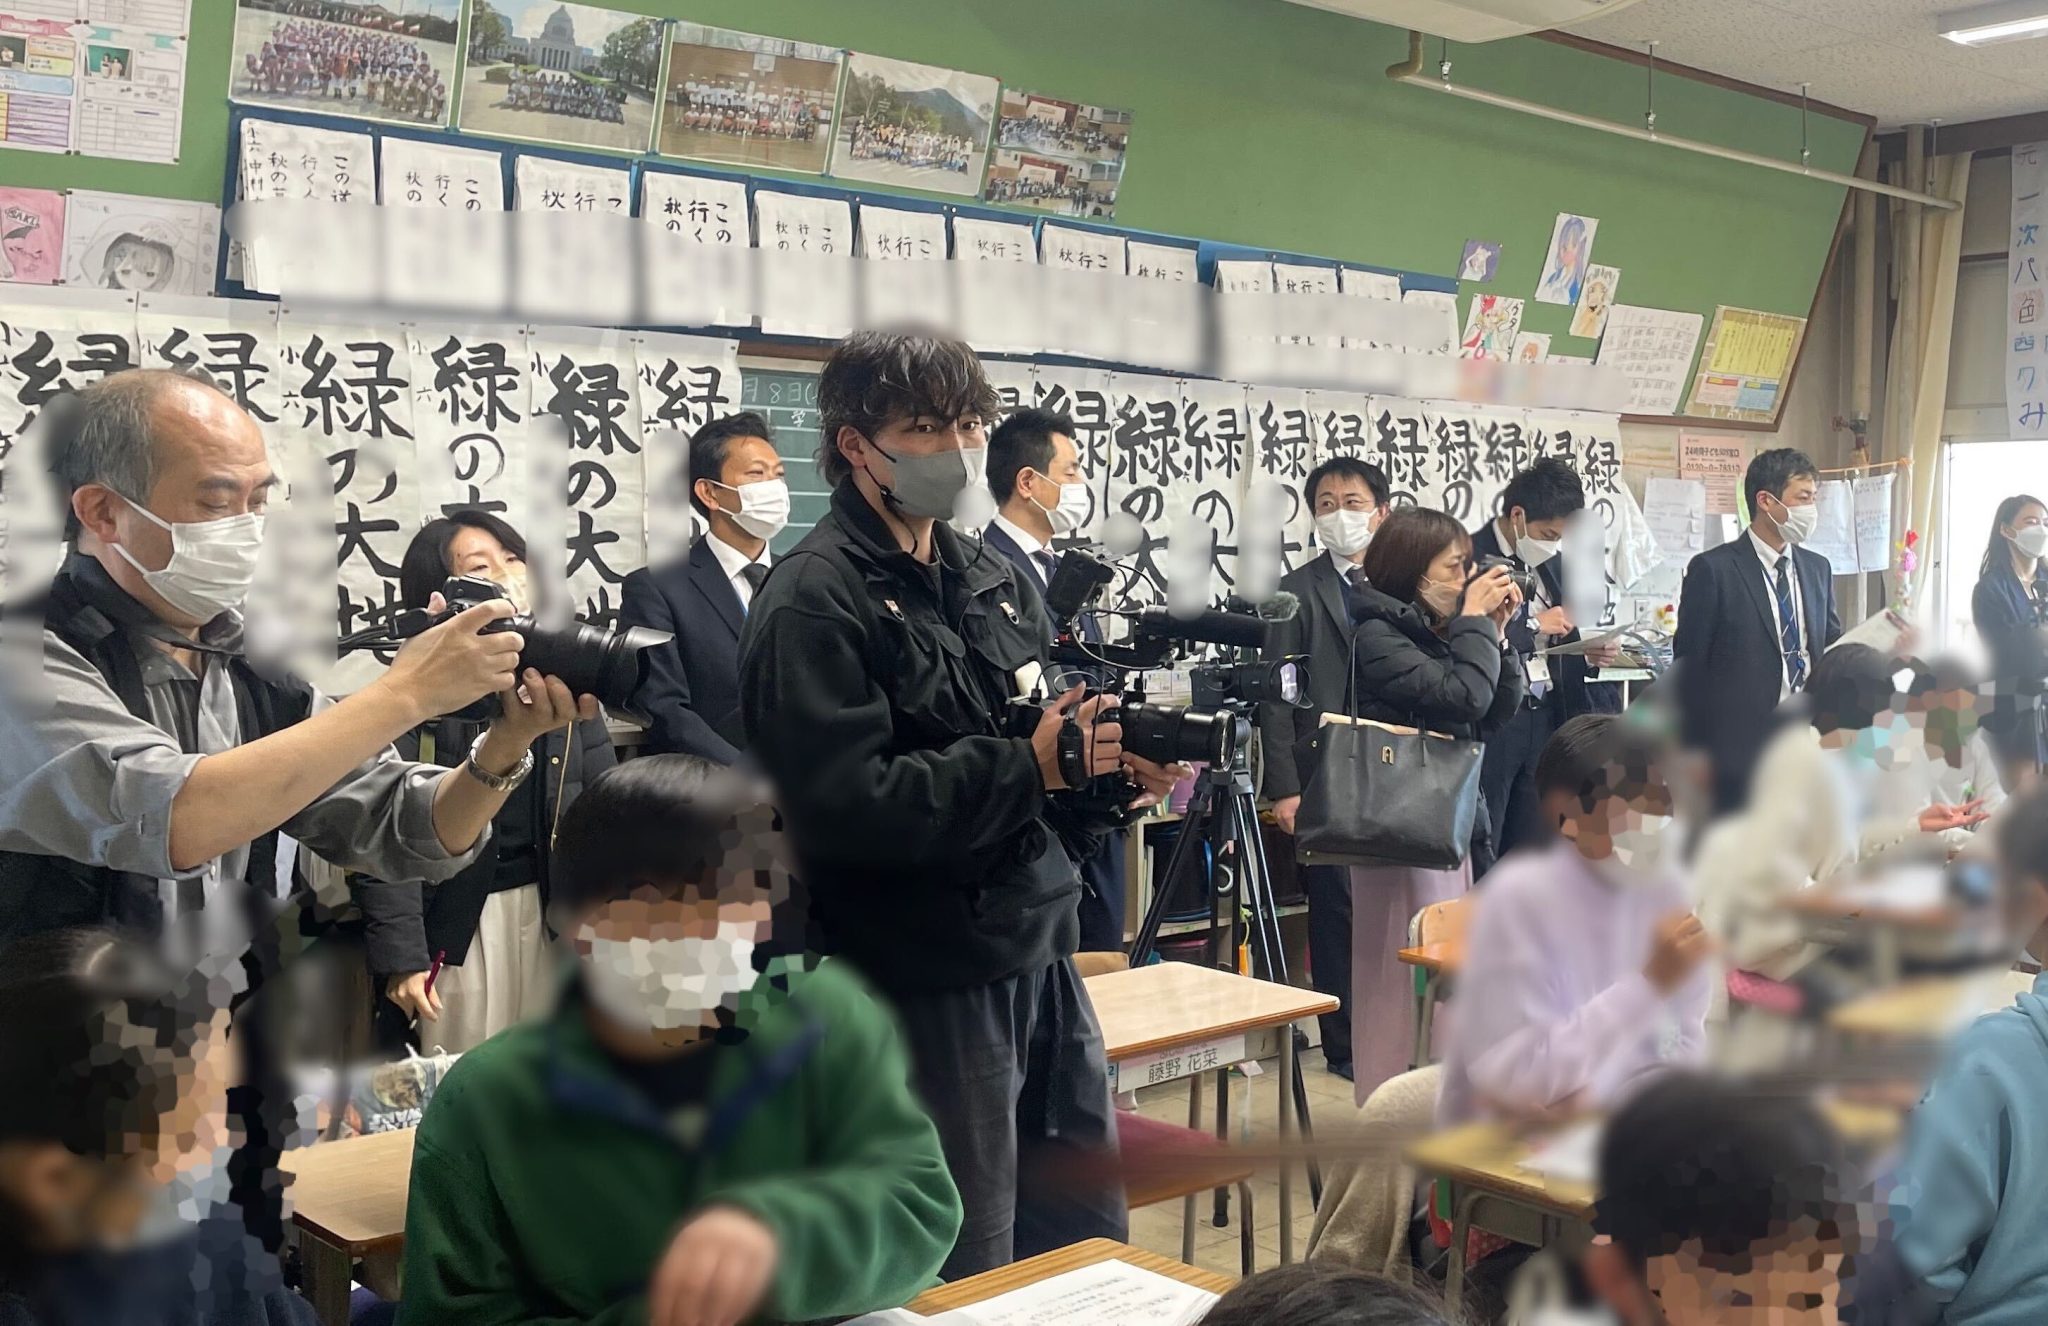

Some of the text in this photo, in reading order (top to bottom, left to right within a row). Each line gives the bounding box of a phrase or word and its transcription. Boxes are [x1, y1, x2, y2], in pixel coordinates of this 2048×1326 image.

[406, 171, 423, 202] 秋の
[434, 174, 450, 207] 行く
[465, 179, 481, 211] この
[664, 196, 682, 231] 秋の
[688, 200, 709, 243] 行く
[716, 202, 731, 243] この
[821, 227, 833, 253] この
